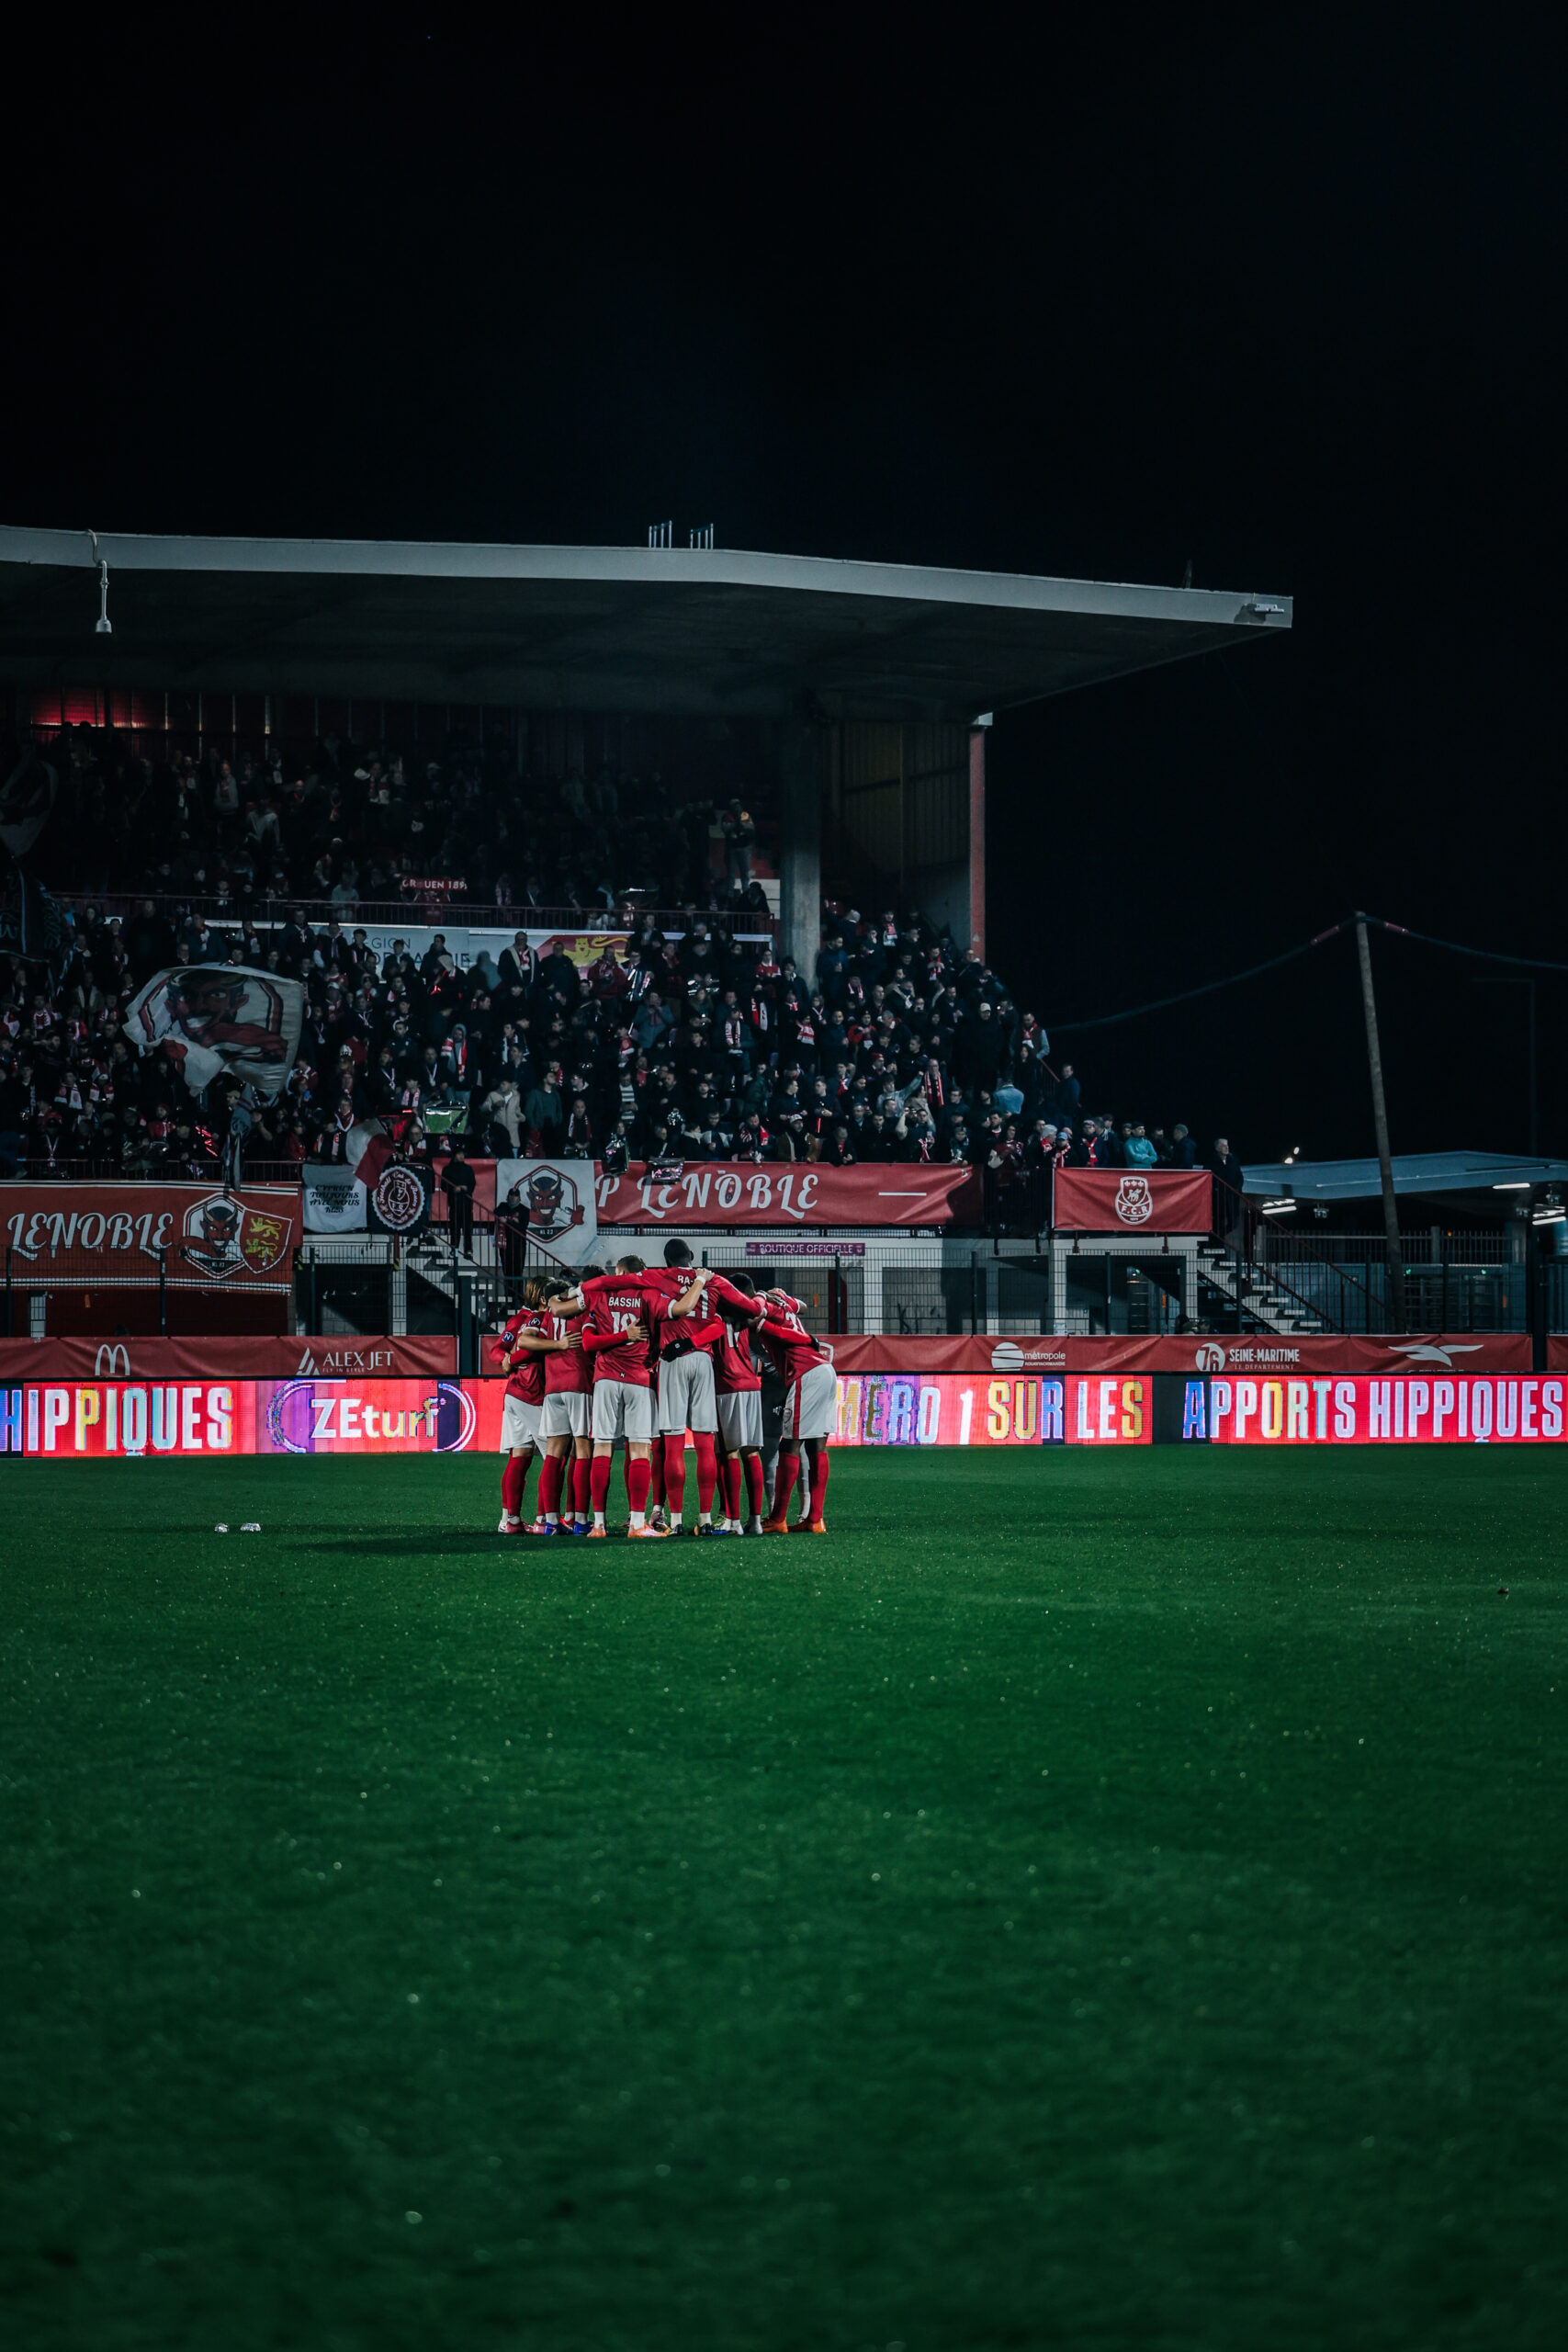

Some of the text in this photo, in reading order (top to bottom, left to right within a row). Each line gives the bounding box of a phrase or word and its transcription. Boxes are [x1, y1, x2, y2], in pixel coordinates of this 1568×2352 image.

[410, 878, 445, 889] RUEN
[637, 1173, 818, 1219] LENOBLE
[7, 1212, 174, 1261] LENOBLE
[759, 1244, 805, 1254] BOUTIQUE
[806, 1244, 853, 1254] OFFICIELLE
[608, 1296, 641, 1308] BASSIN
[552, 1317, 567, 1340] 11
[322, 1351, 394, 1371] ALEX JET
[1024, 1351, 1066, 1362] métropole
[1197, 1346, 1220, 1371] 76
[1229, 1348, 1301, 1363] SEINE-MARITIME
[0, 1387, 231, 1456] HIPPIQUES
[310, 1397, 436, 1439] ZEturf
[958, 1388, 972, 1444] 1
[988, 1381, 1063, 1440] SUR
[1077, 1381, 1143, 1440] LES
[1183, 1381, 1562, 1443] APPORTS HIPPIQUES
